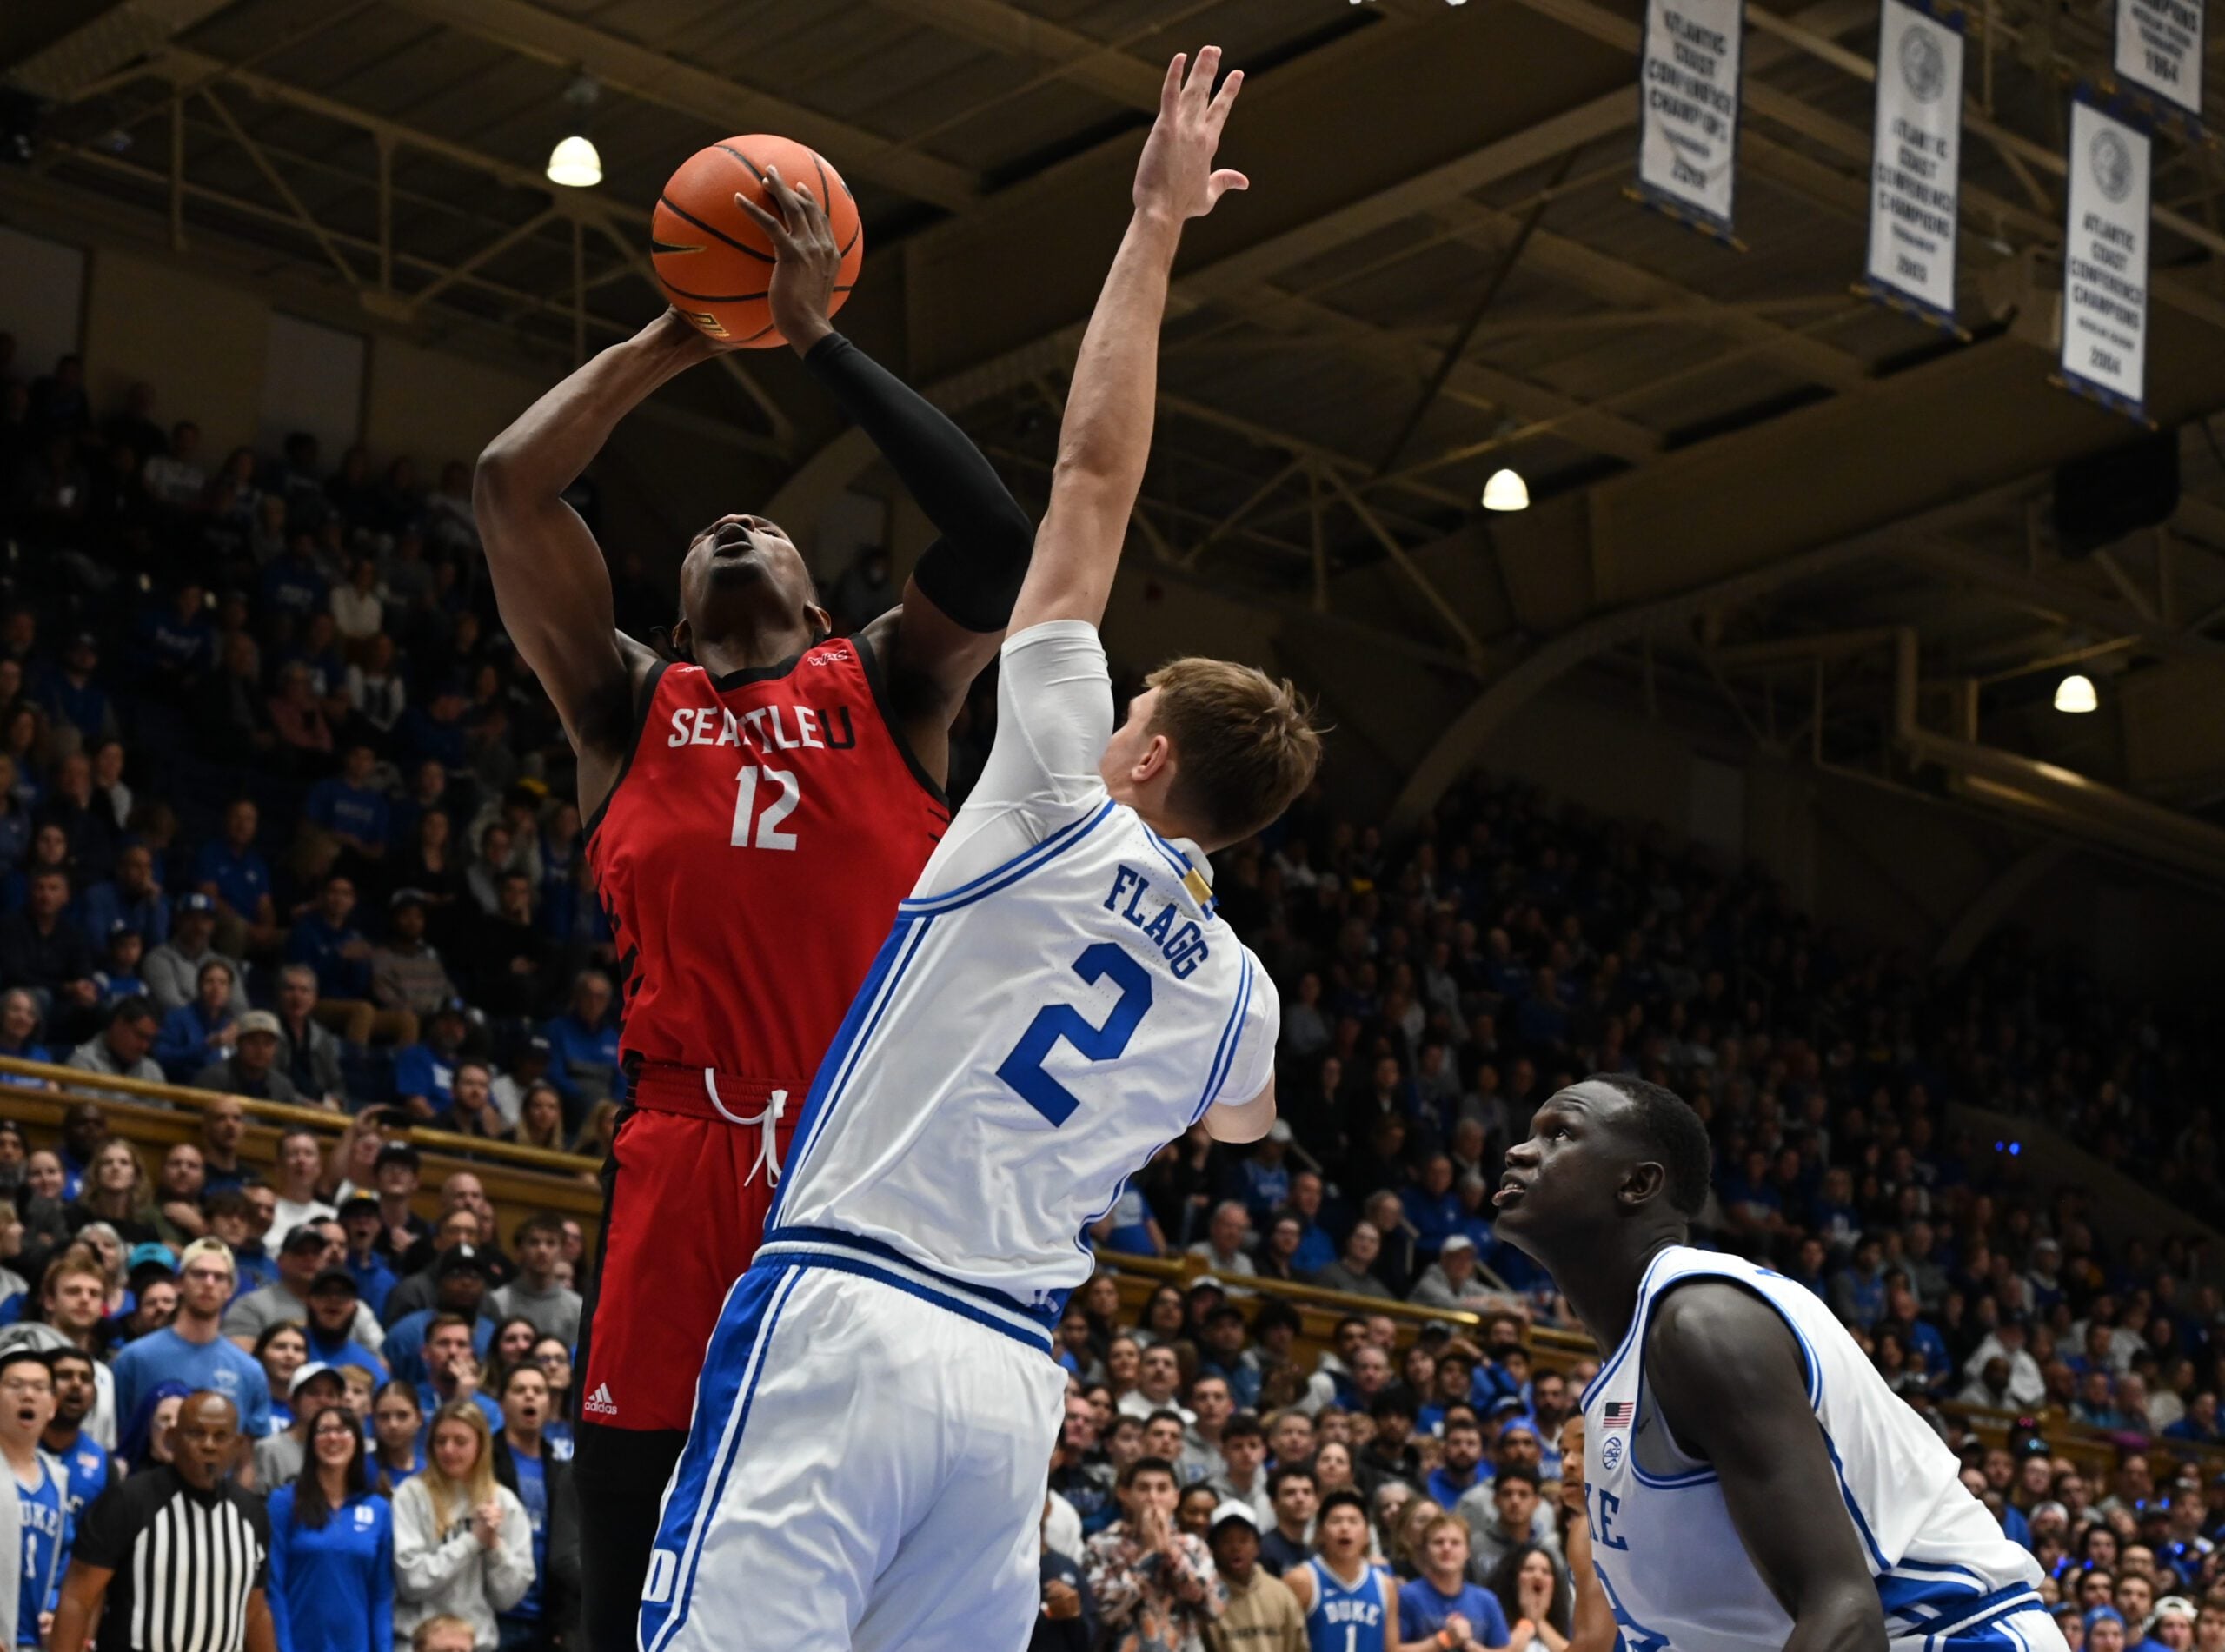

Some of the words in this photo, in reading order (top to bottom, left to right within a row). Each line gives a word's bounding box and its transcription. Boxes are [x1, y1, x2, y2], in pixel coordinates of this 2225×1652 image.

[807, 650, 848, 667] WAC
[730, 764, 800, 852] 12
[1103, 864, 1209, 980] FLAGG
[995, 942, 1153, 1128] 2
[584, 1401, 618, 1416] adidas
[1323, 1599, 1380, 1627] DUKE
[1345, 1624, 1357, 1652] 1
